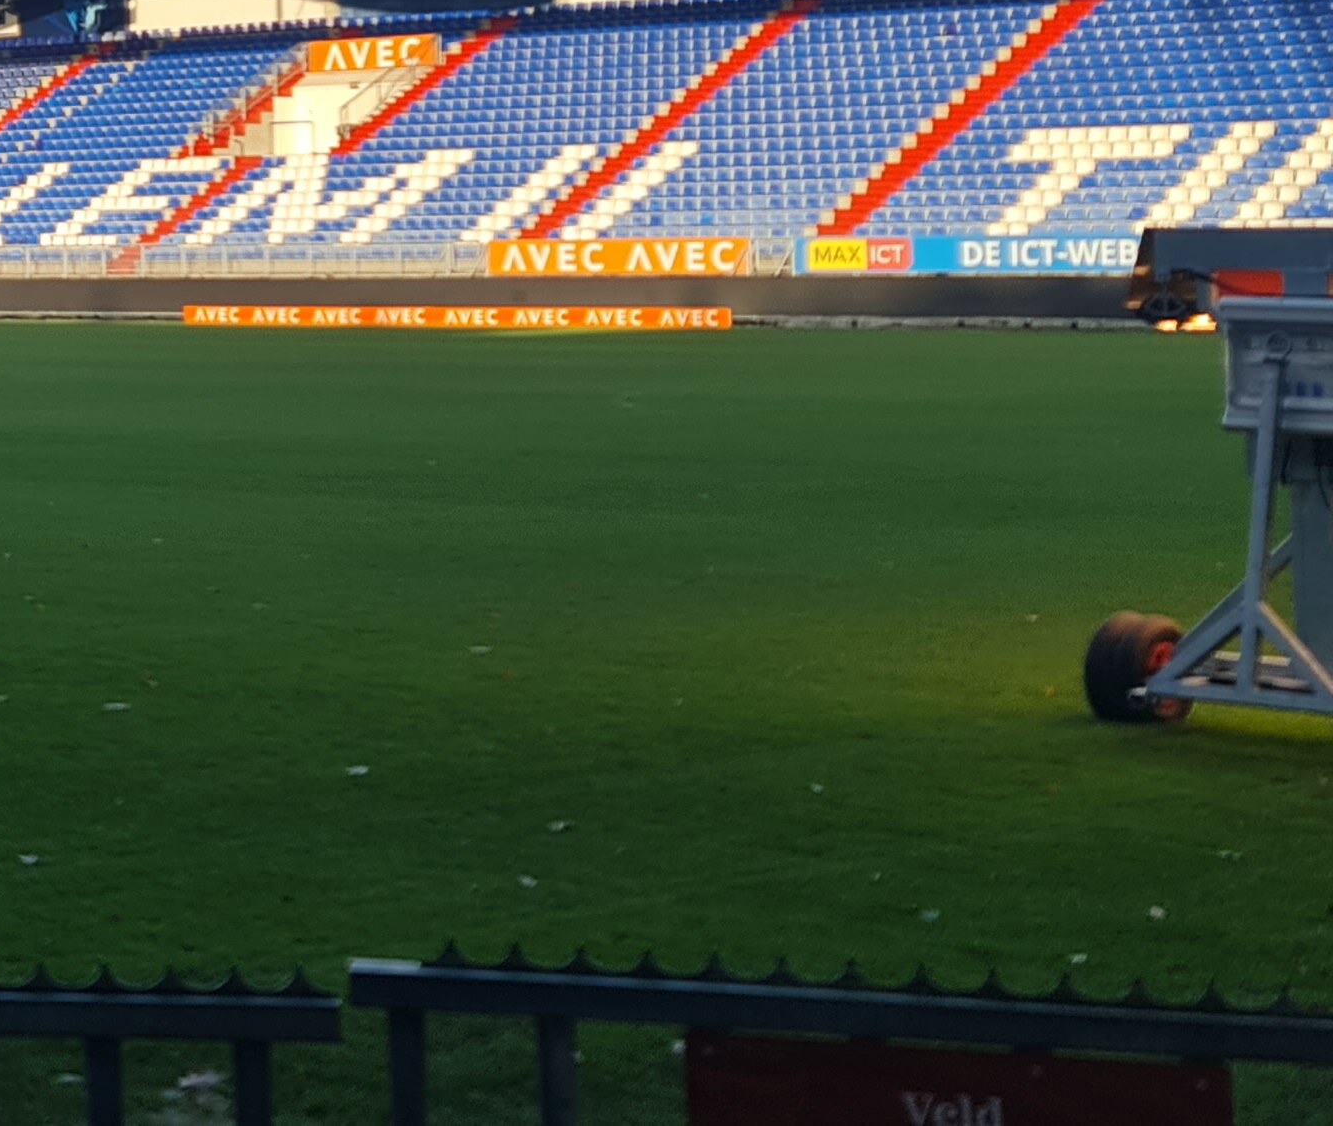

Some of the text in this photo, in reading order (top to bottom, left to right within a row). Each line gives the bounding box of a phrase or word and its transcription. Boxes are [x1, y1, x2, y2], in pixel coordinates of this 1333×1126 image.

[324, 38, 420, 70] AVEC
[501, 241, 735, 271] AVEC AVEC
[814, 245, 905, 264] MAX ICT
[961, 241, 1000, 266] DE
[194, 308, 718, 327] AVEC AVEC AVEC AVEC AVEC AVEC AVEC AVEC
[900, 1090, 1005, 1126] Veld
